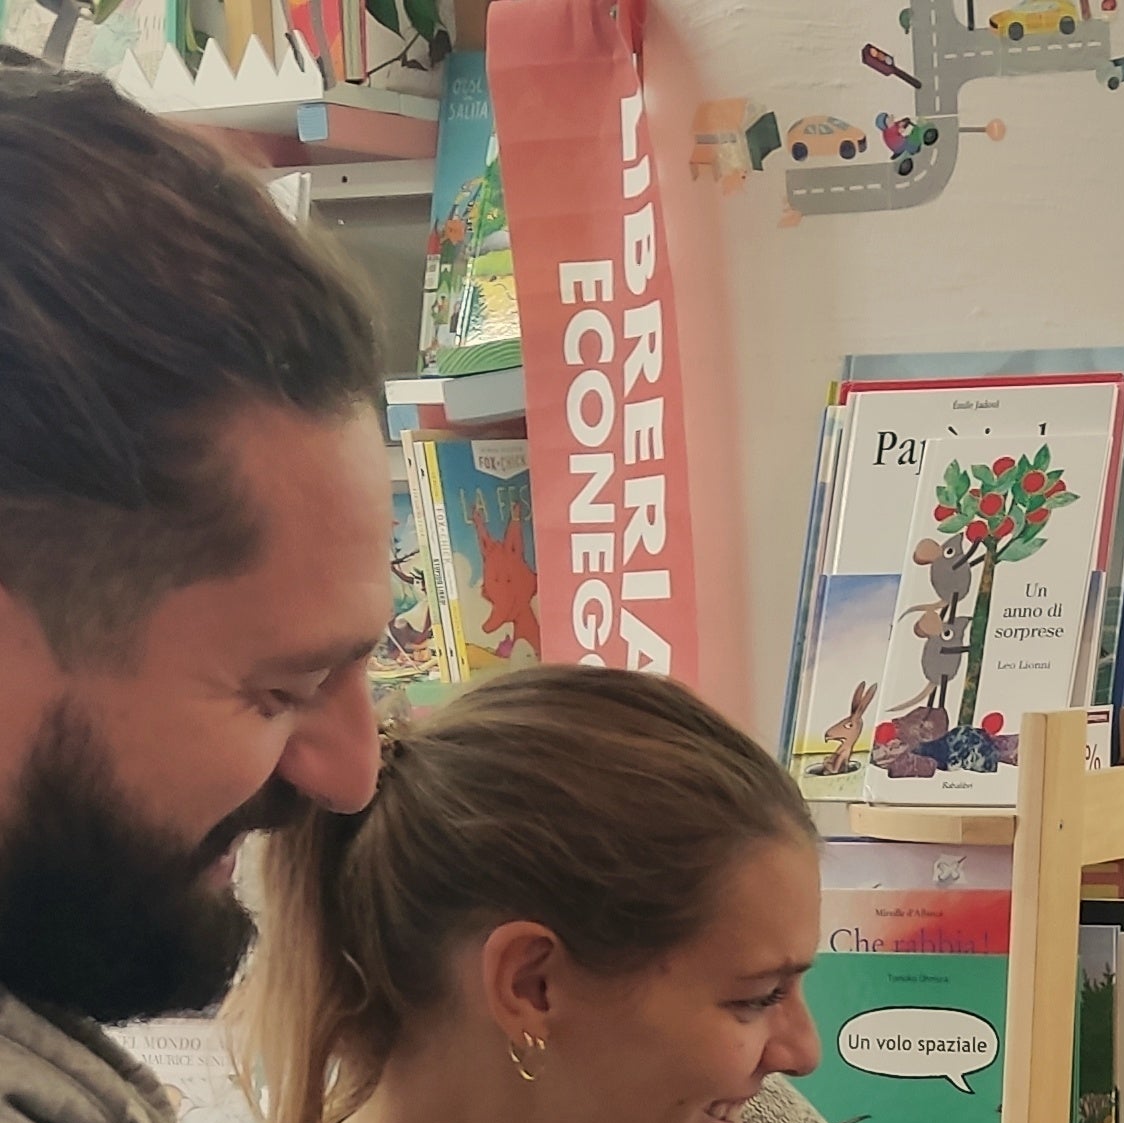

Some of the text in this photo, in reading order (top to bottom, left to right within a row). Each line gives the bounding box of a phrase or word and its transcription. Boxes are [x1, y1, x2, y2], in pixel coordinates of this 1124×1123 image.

[620, 85, 673, 677] LIBRERIA
[558, 259, 616, 668] ECONEG
[1025, 582, 1047, 598] Un
[1003, 602, 1063, 618] anno di
[994, 625, 1064, 641] sorprese
[997, 660, 1051, 670] Leo Lionni
[829, 927, 884, 953] Che
[848, 1034, 988, 1056] Un volo spaziale
